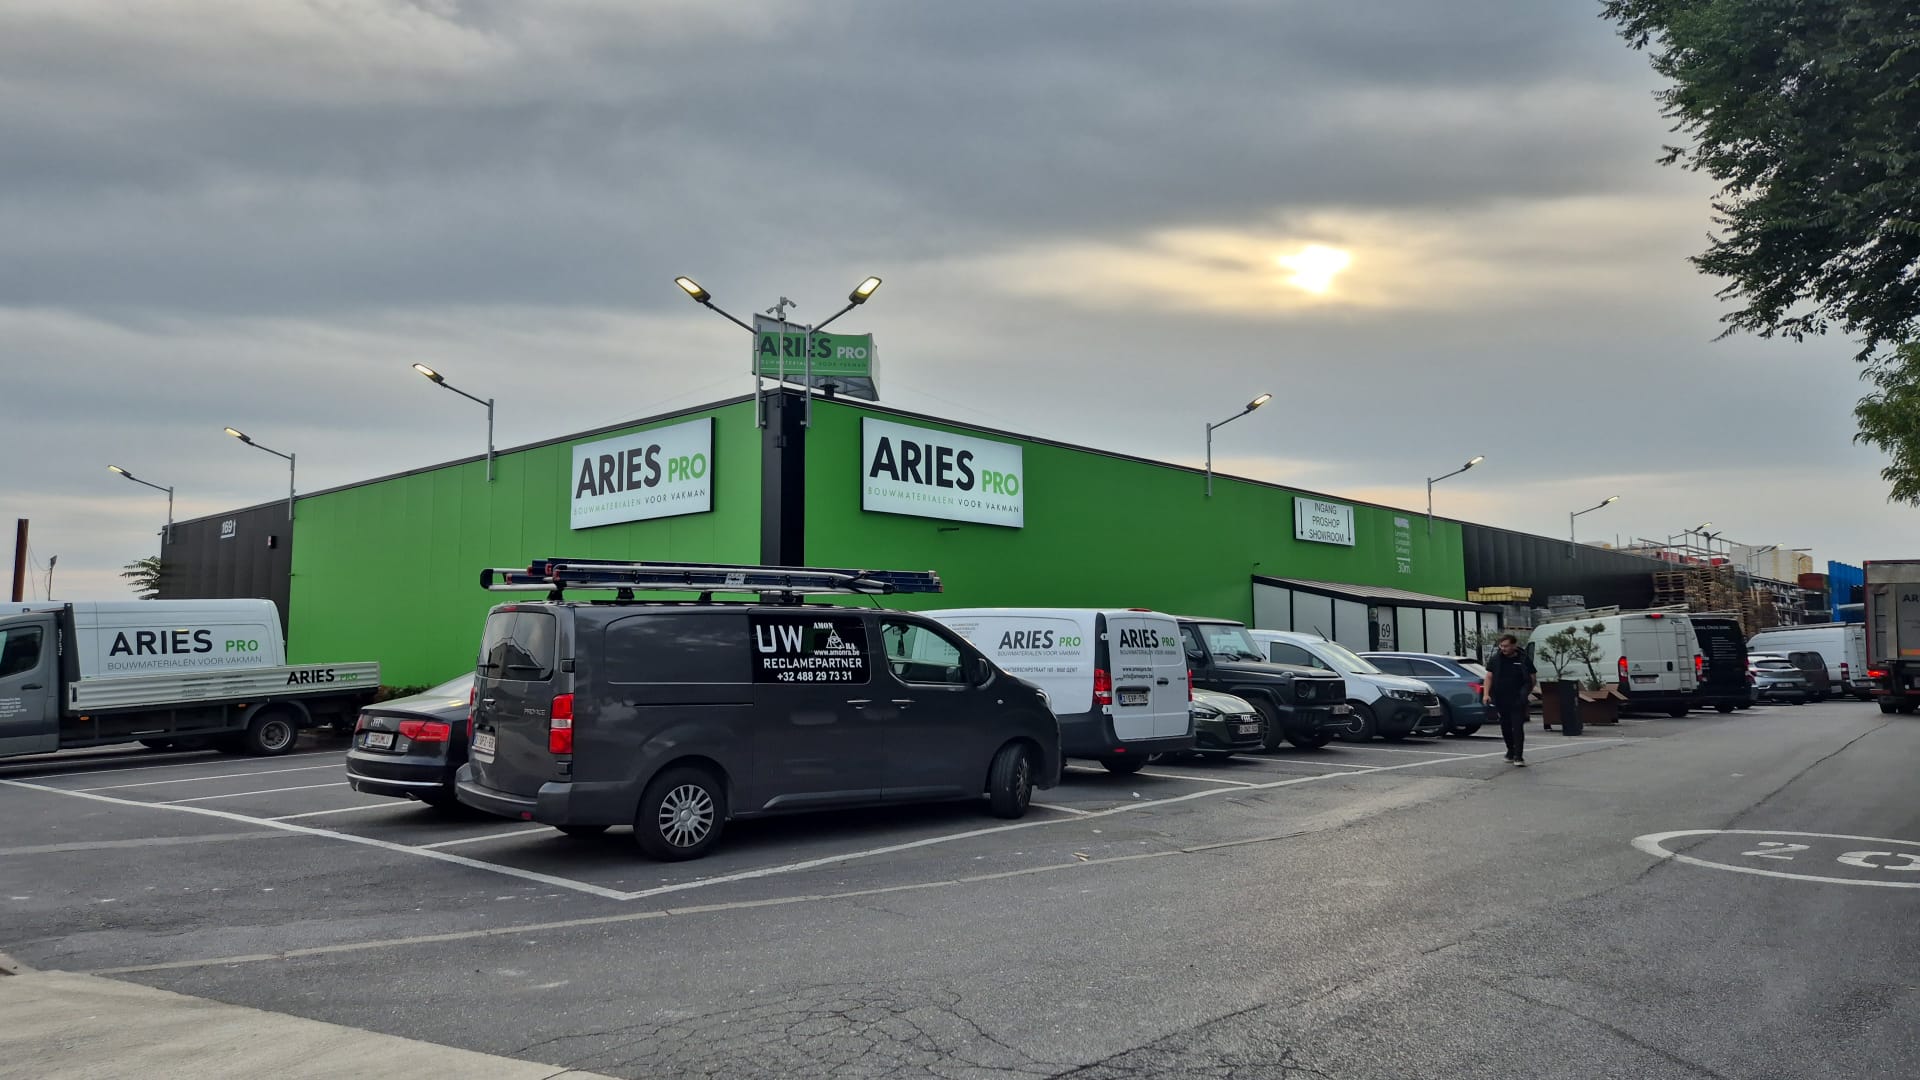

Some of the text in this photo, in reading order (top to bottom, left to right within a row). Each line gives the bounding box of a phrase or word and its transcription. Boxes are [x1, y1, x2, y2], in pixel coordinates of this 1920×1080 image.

[760, 336, 867, 359] ARIES PRO
[575, 444, 706, 499] ARIES PRO
[869, 436, 1019, 497] ARIES PRO
[573, 489, 706, 516] BOUWMATERIALEN VOOR VAKMAN
[868, 486, 1019, 513] BOUWMATERIALEN VOOR VAKMAN
[1314, 503, 1337, 515] INGANG
[1312, 515, 1340, 528] PROSHOP
[1308, 529, 1345, 542] SHOWROOM
[813, 622, 834, 630] AMON
[109, 629, 259, 657] ARIES PRO
[756, 625, 804, 653] UW
[999, 630, 1081, 649] ARIES PRO
[1120, 629, 1175, 648] ARIES PRO
[107, 659, 196, 670] BOUWMATERIALEN
[226, 655, 262, 664] VAKMAN
[763, 658, 862, 669] RECLAMEPARTNER
[287, 669, 358, 685] ARIES PRO
[777, 671, 852, 681] +32 488 29 73 31
